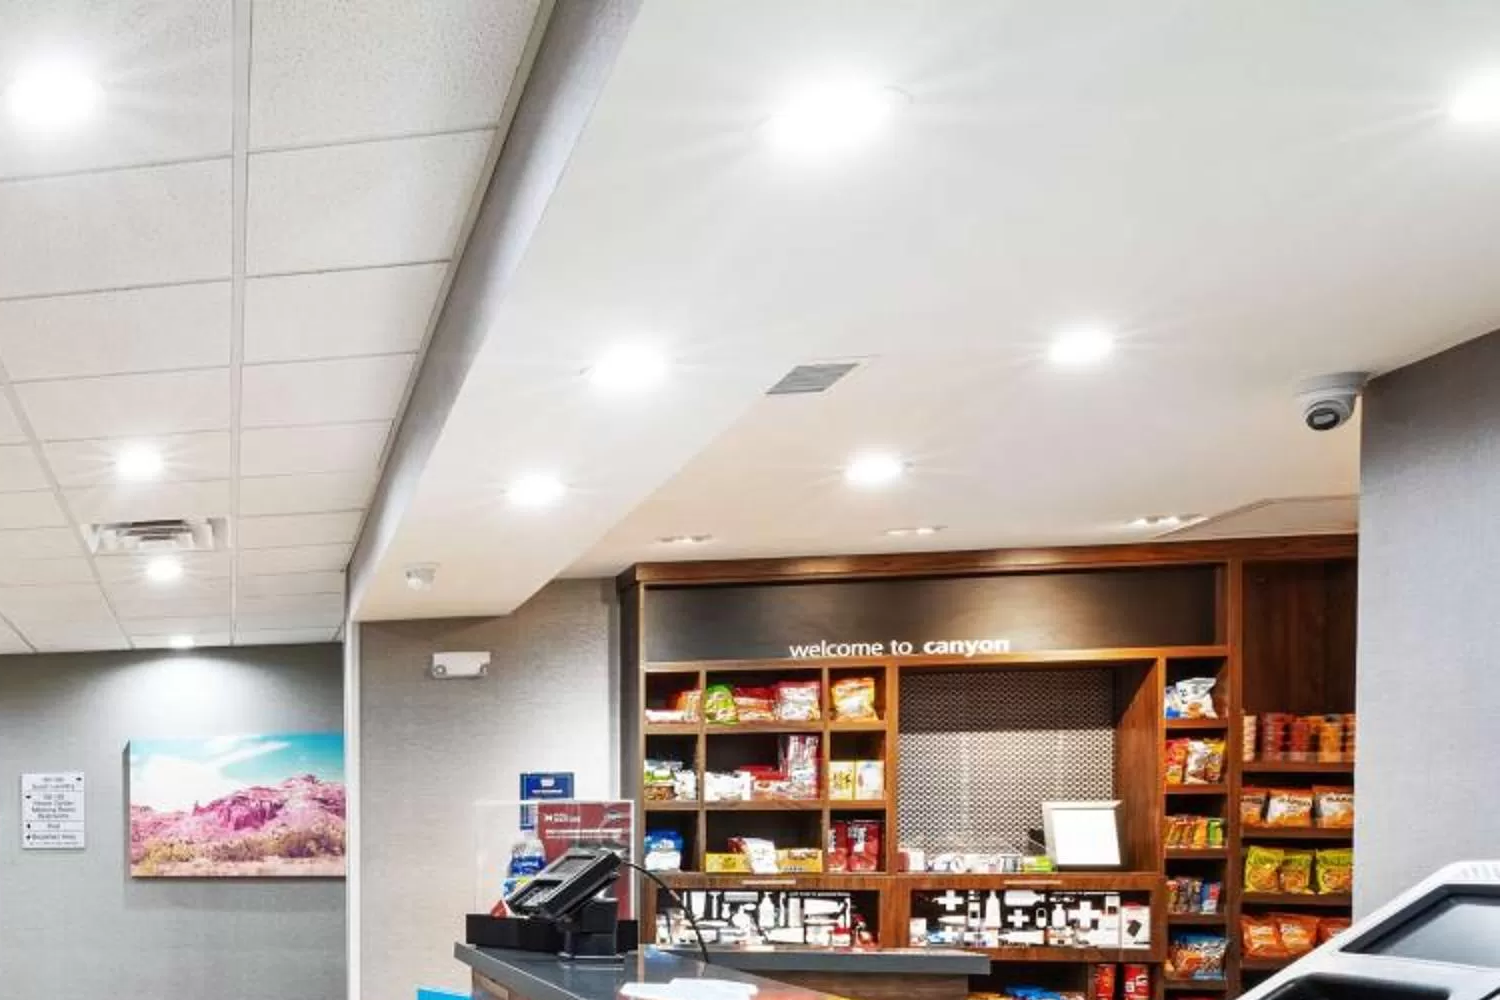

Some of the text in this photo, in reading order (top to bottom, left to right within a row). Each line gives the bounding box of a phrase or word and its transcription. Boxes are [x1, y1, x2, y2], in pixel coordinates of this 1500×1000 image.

[788, 639, 1011, 659] welcome to canyon
